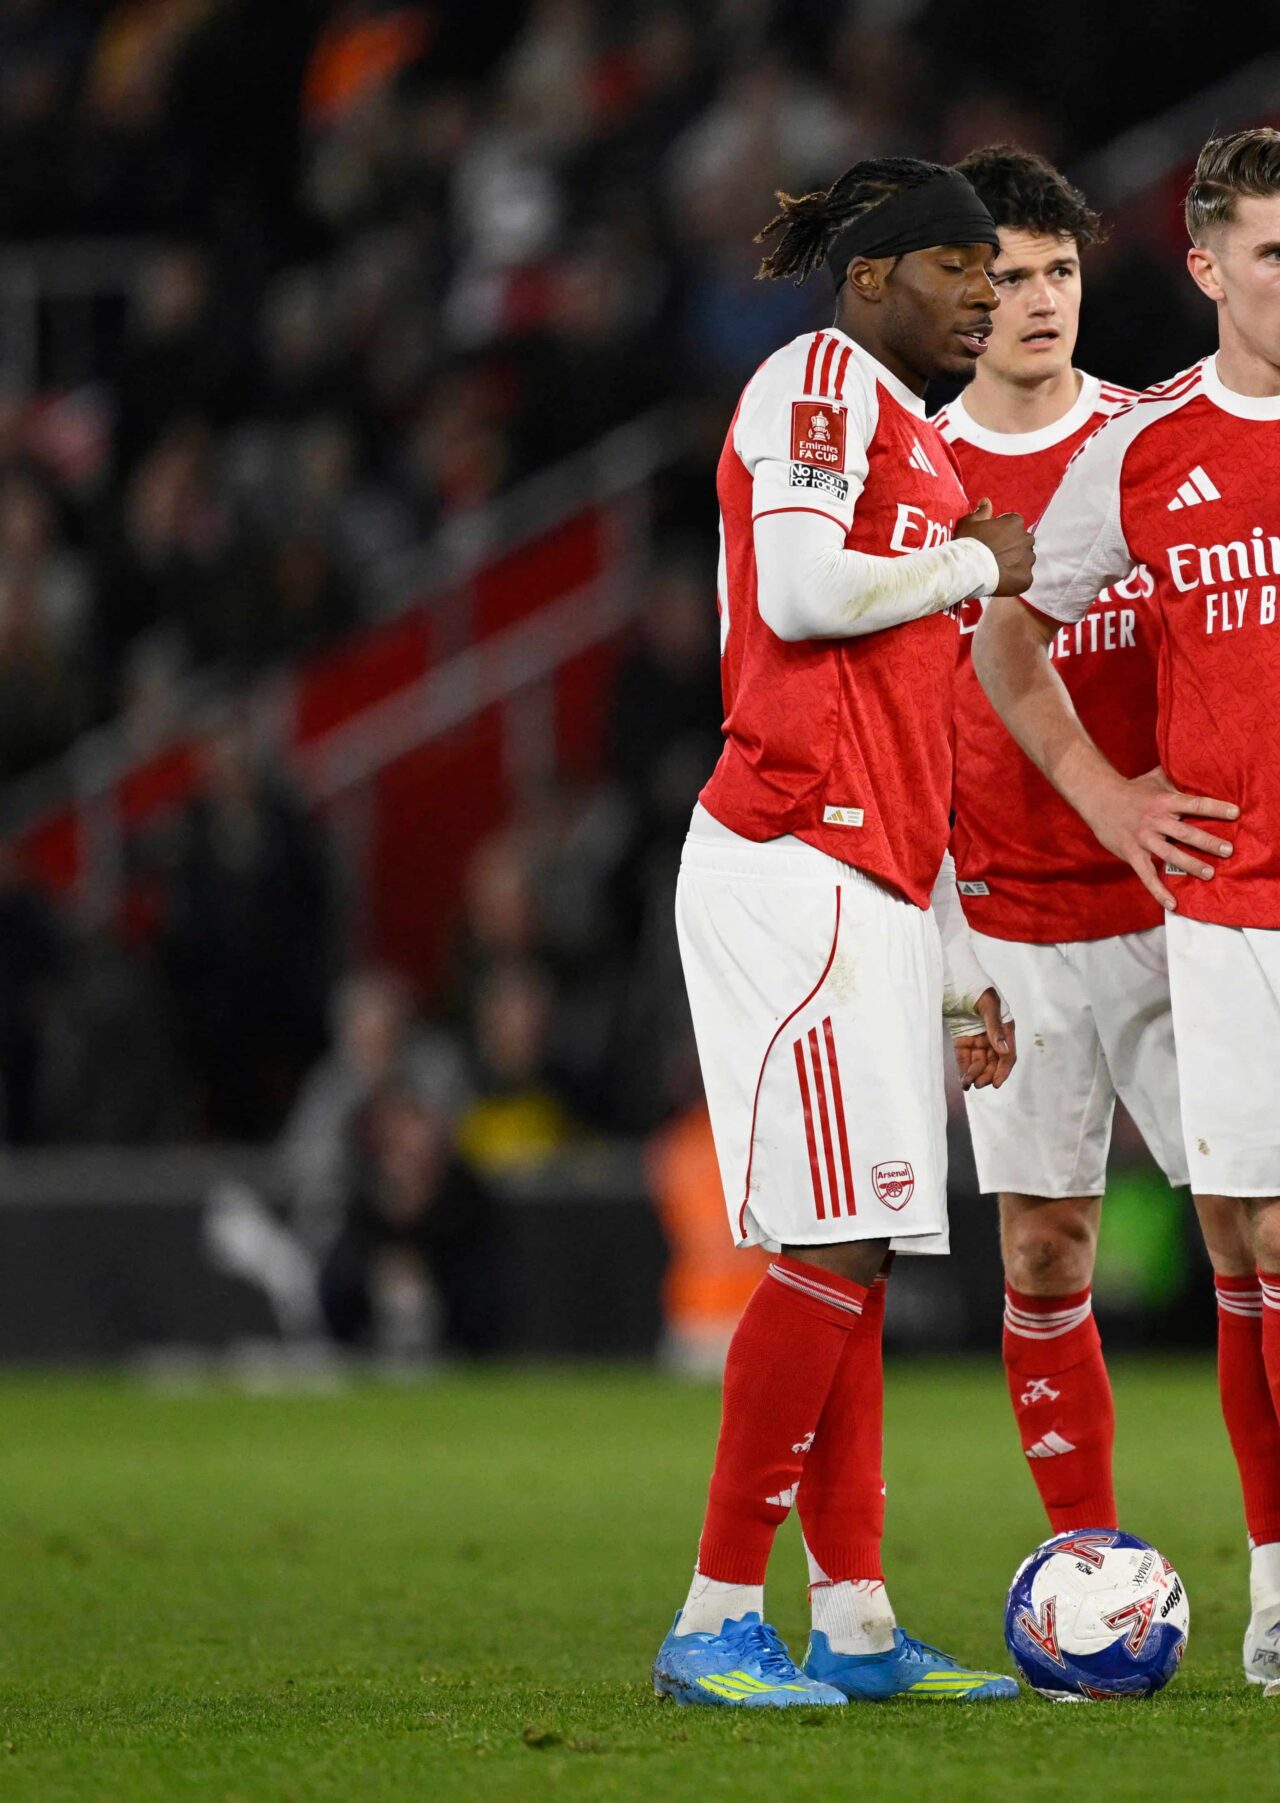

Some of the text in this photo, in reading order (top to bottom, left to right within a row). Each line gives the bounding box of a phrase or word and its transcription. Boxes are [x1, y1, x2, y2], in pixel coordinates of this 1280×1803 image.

[799, 441, 838, 453] Emirates
[799, 449, 839, 462] FA CUP
[790, 464, 811, 477] No
[1206, 588, 1249, 635] FLY
[1048, 609, 1136, 660] ETTER
[877, 1169, 909, 1180] Arsenal
